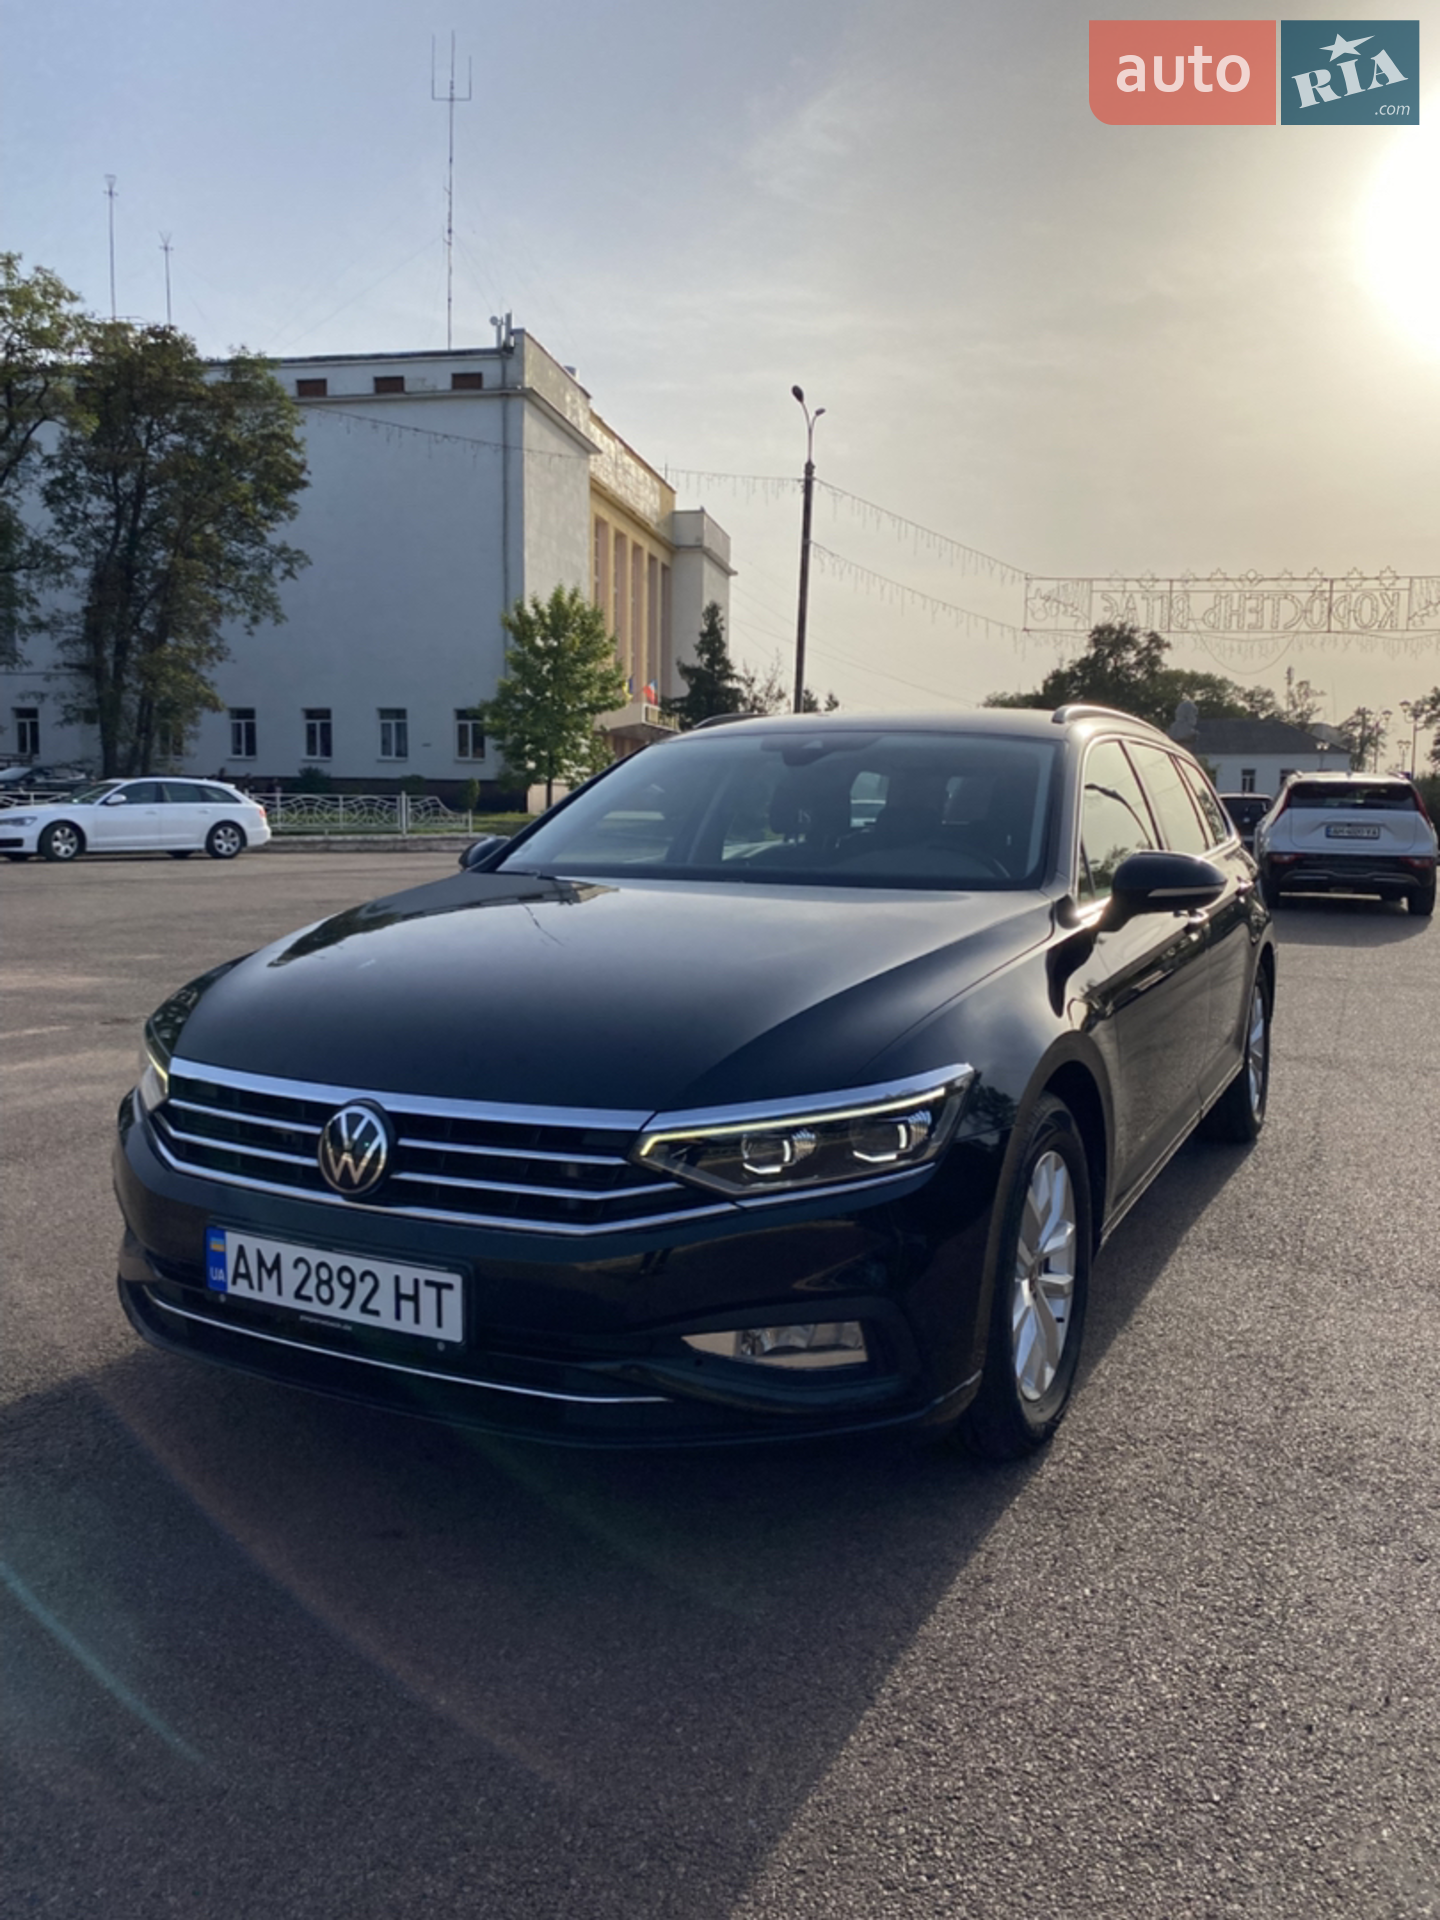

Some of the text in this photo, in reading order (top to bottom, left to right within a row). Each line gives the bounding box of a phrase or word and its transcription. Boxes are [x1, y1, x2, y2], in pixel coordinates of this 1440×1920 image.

[209, 1266, 227, 1282] UA
[231, 1244, 454, 1329] AM 2892 HT
